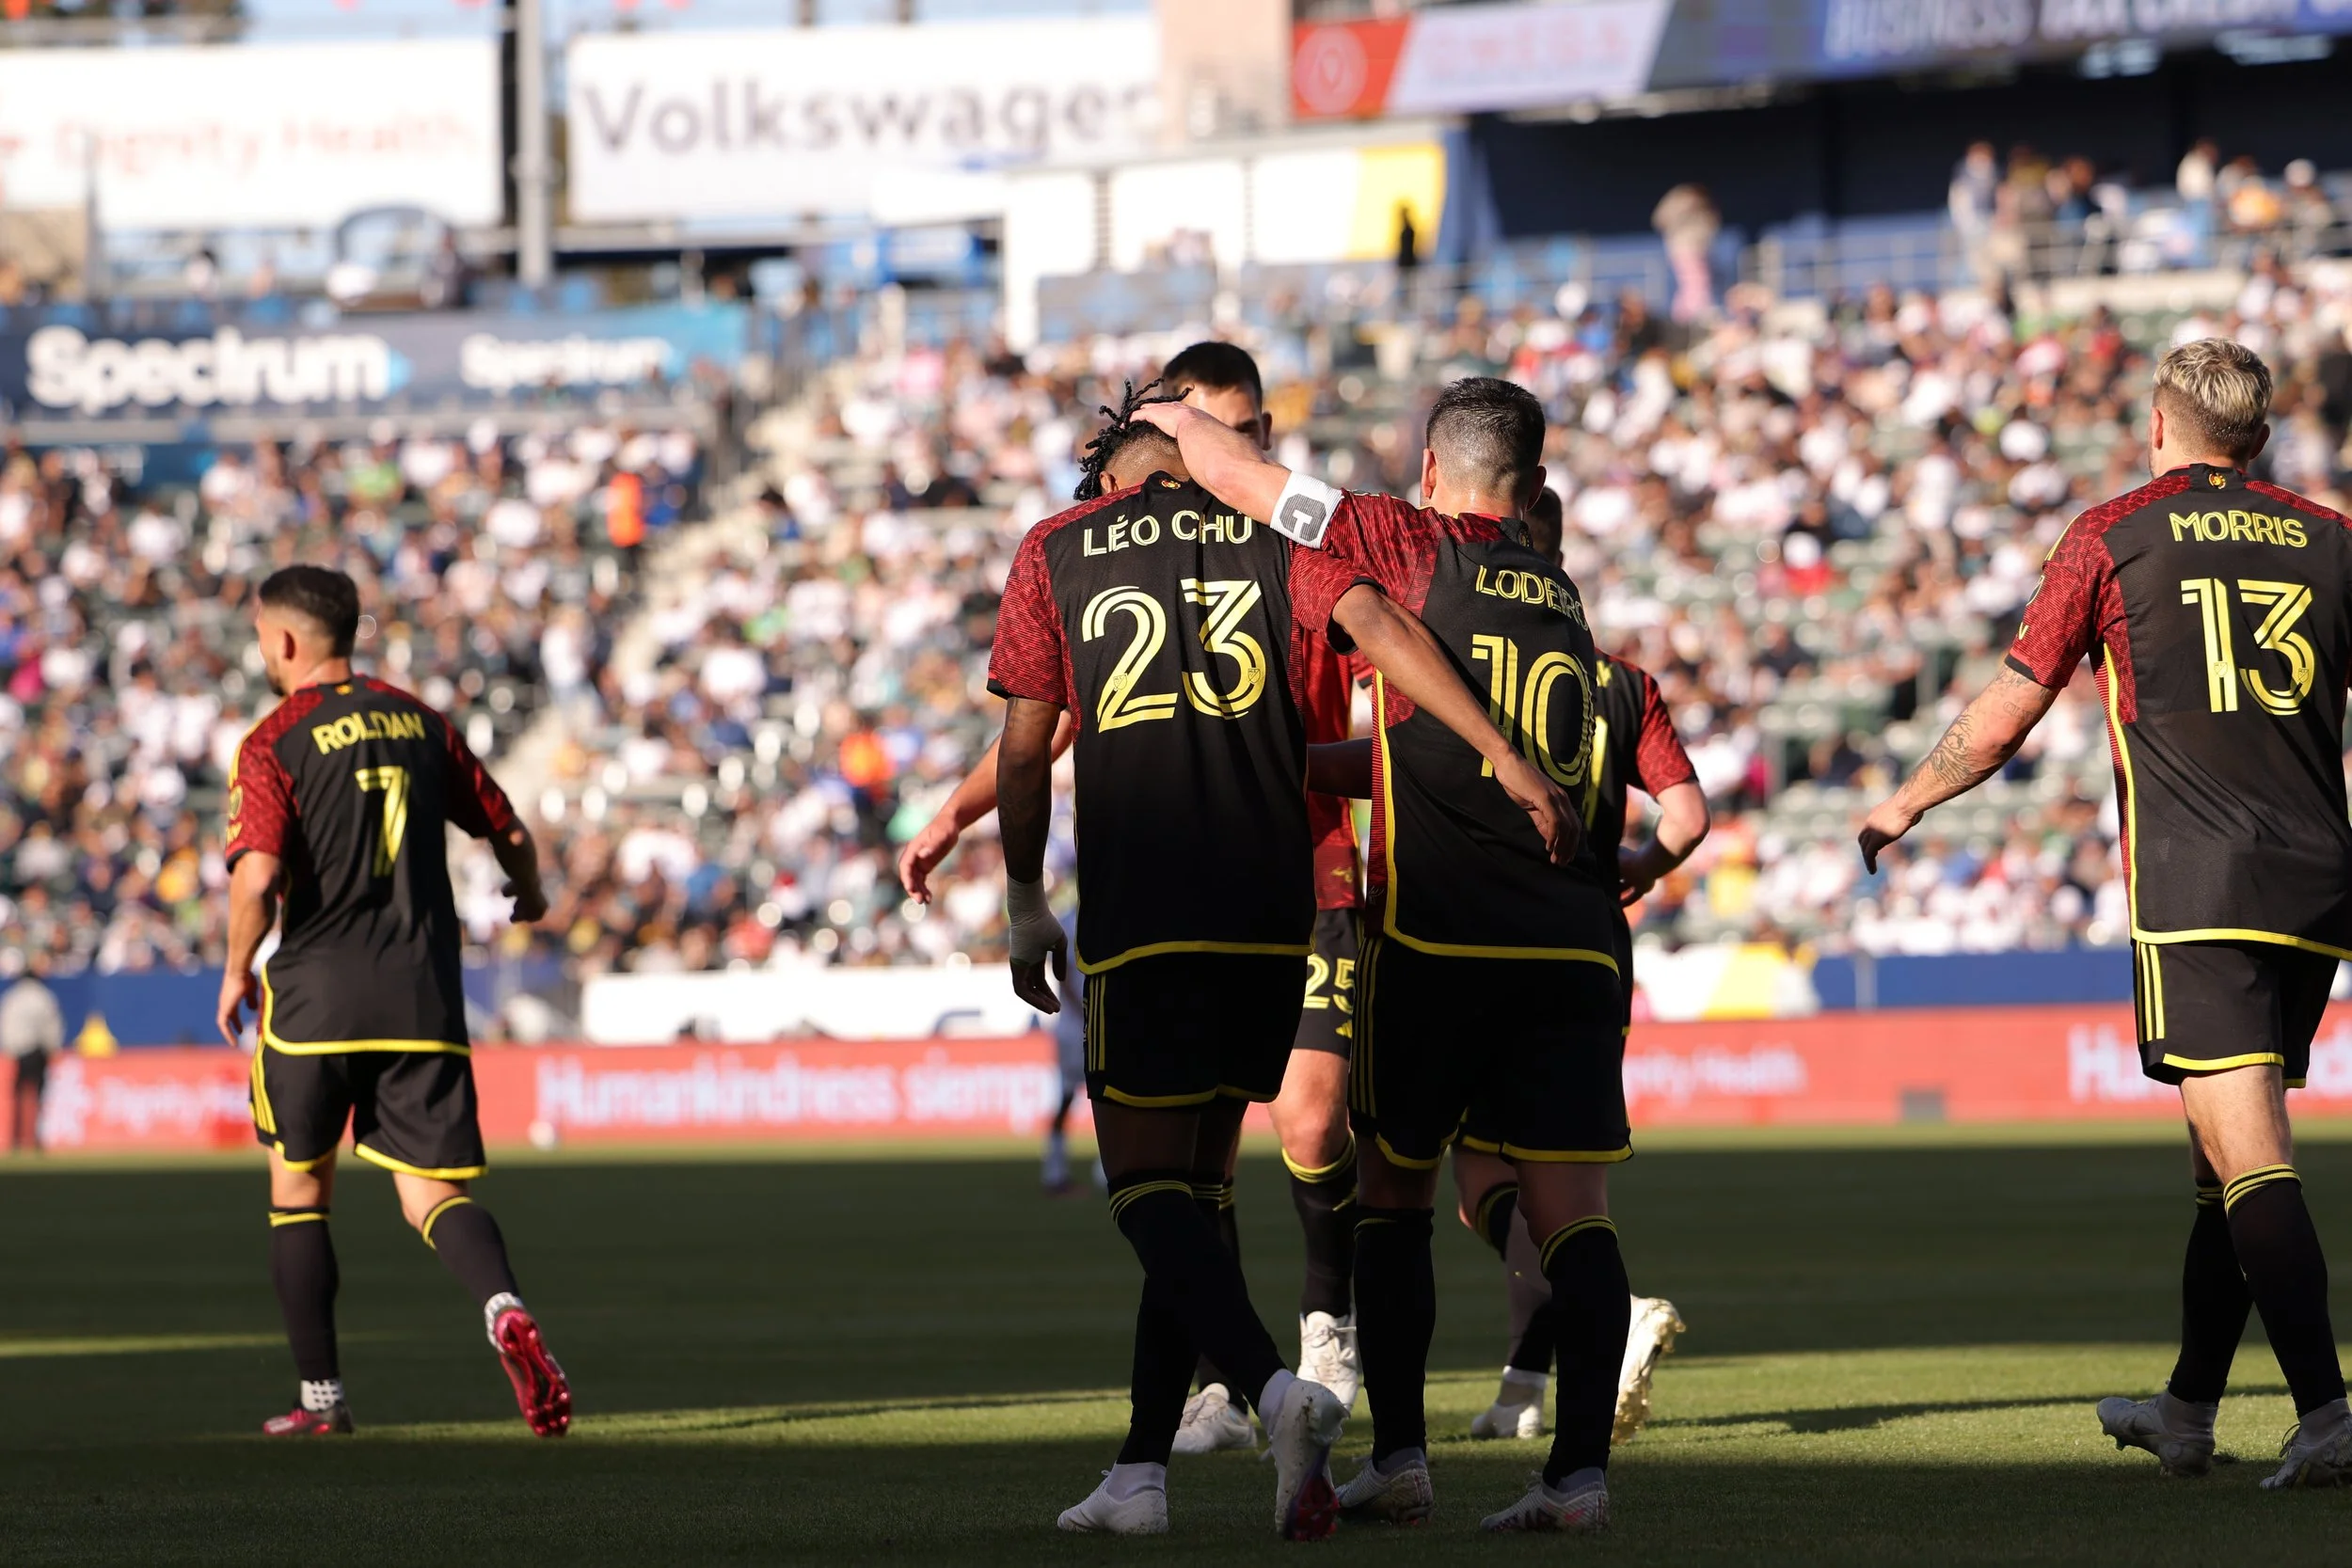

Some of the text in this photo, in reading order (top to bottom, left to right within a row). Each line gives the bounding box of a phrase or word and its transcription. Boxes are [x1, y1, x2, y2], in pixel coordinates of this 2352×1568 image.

[26, 325, 389, 414] Spectrum
[1084, 515, 1161, 558] LÉO
[2169, 510, 2308, 548] MORRIS
[1081, 578, 1266, 734] 23
[2180, 577, 2315, 717] 13
[311, 712, 425, 755] ROLDAN
[1471, 633, 1597, 787] 10
[355, 765, 408, 877] 7
[1302, 952, 1356, 1016] 25
